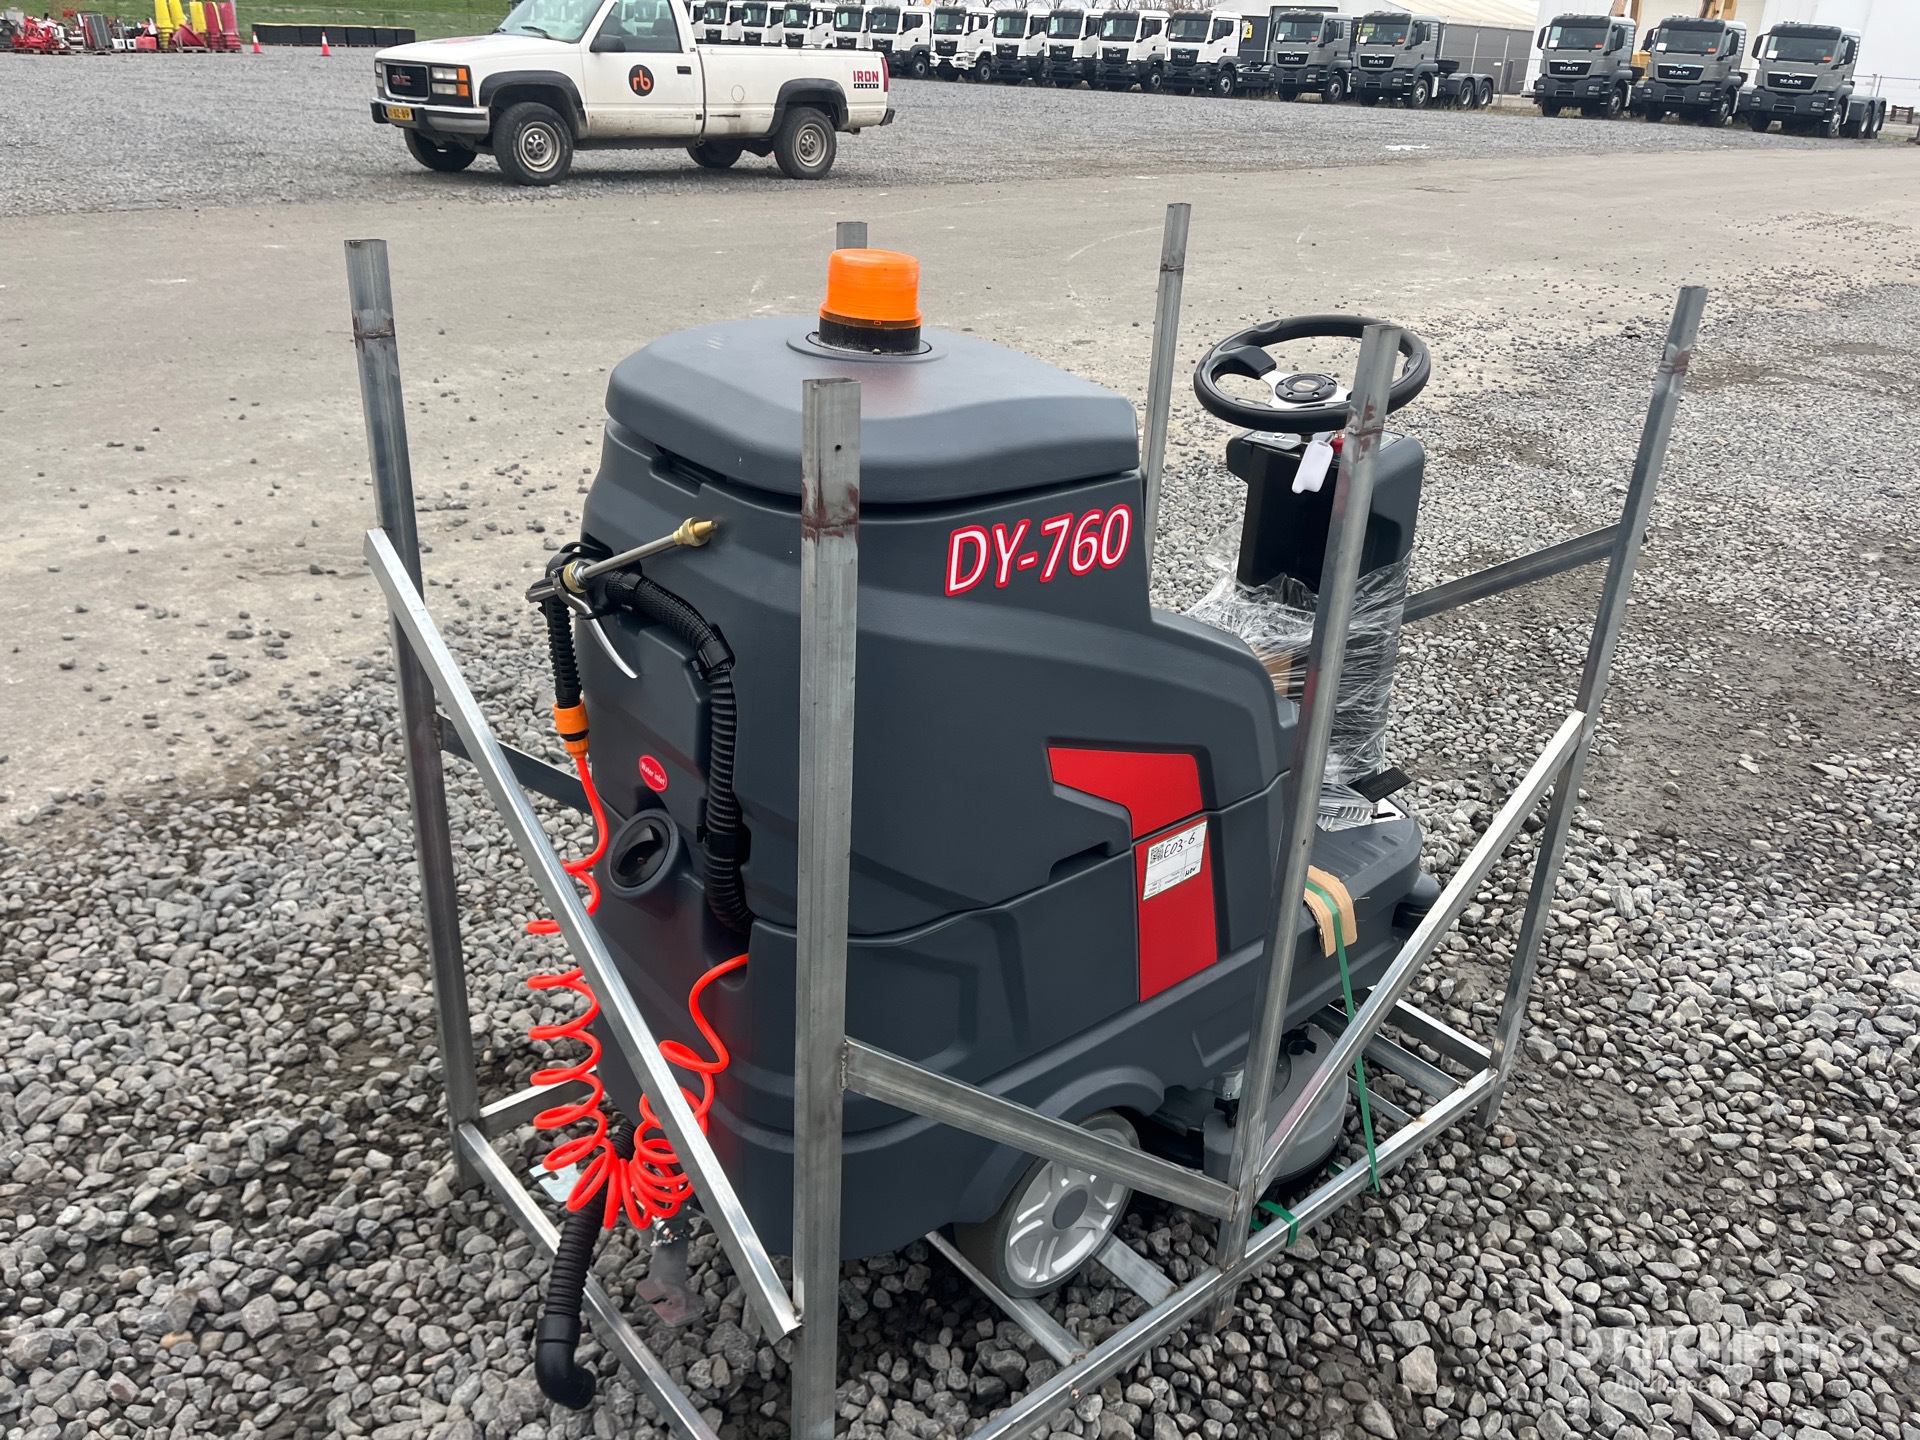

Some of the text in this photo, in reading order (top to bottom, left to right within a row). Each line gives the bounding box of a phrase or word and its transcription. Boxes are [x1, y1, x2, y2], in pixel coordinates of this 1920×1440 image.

[632, 69, 652, 91] rb
[853, 70, 879, 82] IRON
[1779, 78, 1802, 86] MAN
[946, 504, 1131, 596] DY-760
[641, 761, 665, 786] Water inlet
[1163, 832, 1196, 858] E03-6
